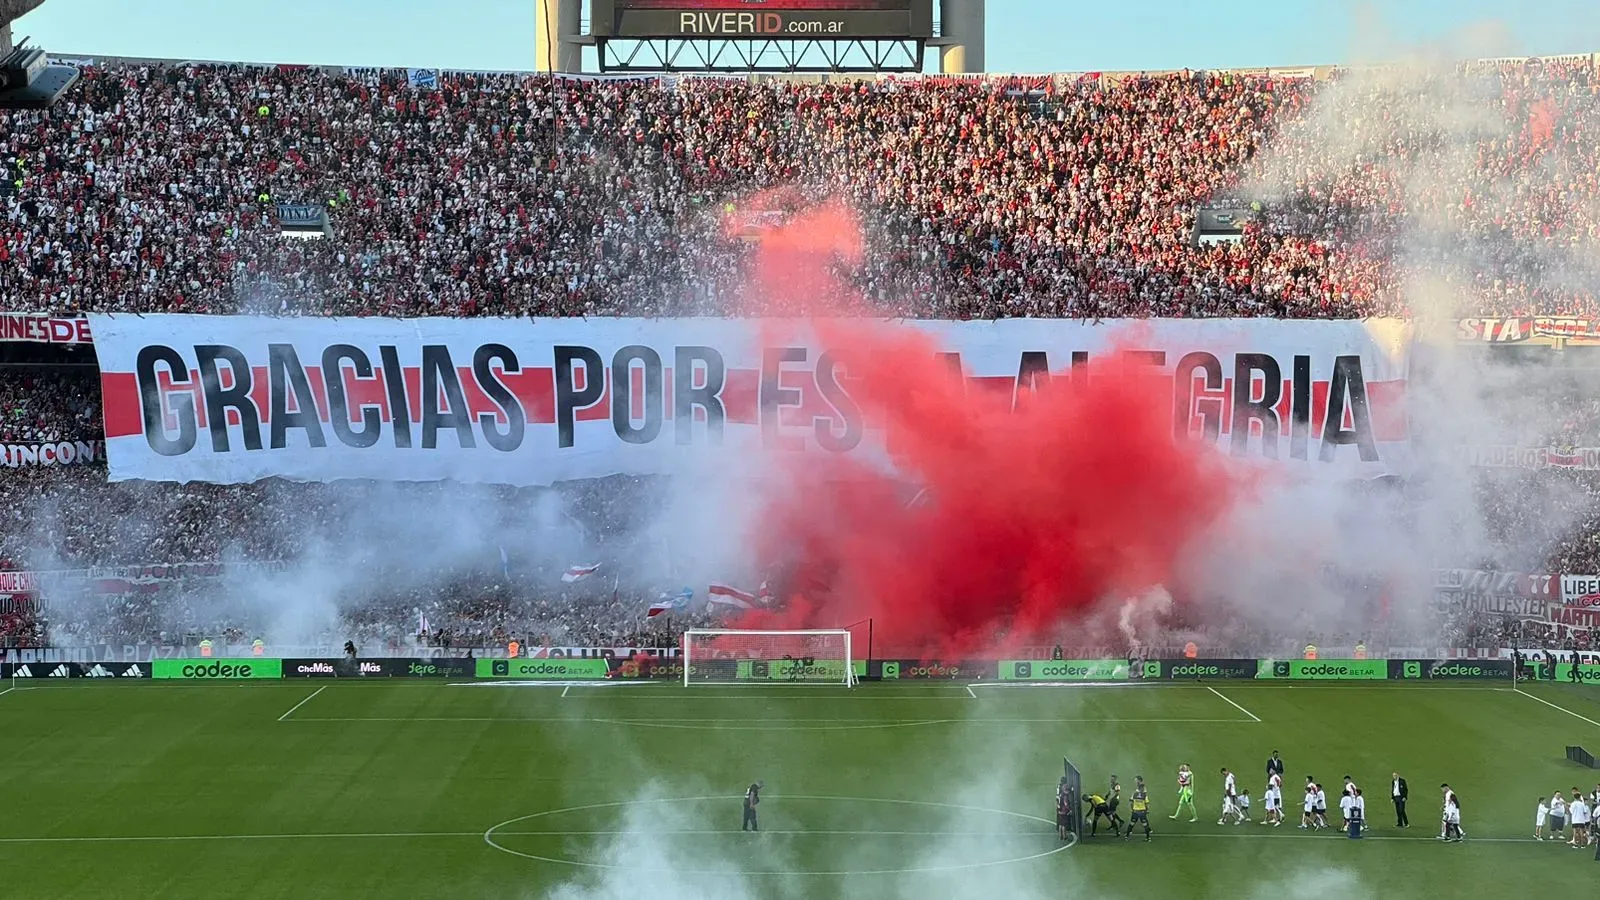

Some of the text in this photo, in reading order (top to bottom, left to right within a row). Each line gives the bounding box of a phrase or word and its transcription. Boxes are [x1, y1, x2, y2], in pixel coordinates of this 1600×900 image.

[136, 343, 527, 456] GRACIAS
[553, 345, 726, 449] POR
[1010, 350, 1382, 462] AGRIA
[182, 660, 252, 677] codere
[408, 662, 436, 674] dere
[520, 663, 566, 674] codere
[650, 663, 697, 675] codee
[1171, 663, 1218, 675] codere
[1300, 664, 1347, 675] codere
[1432, 664, 1481, 676] codere
